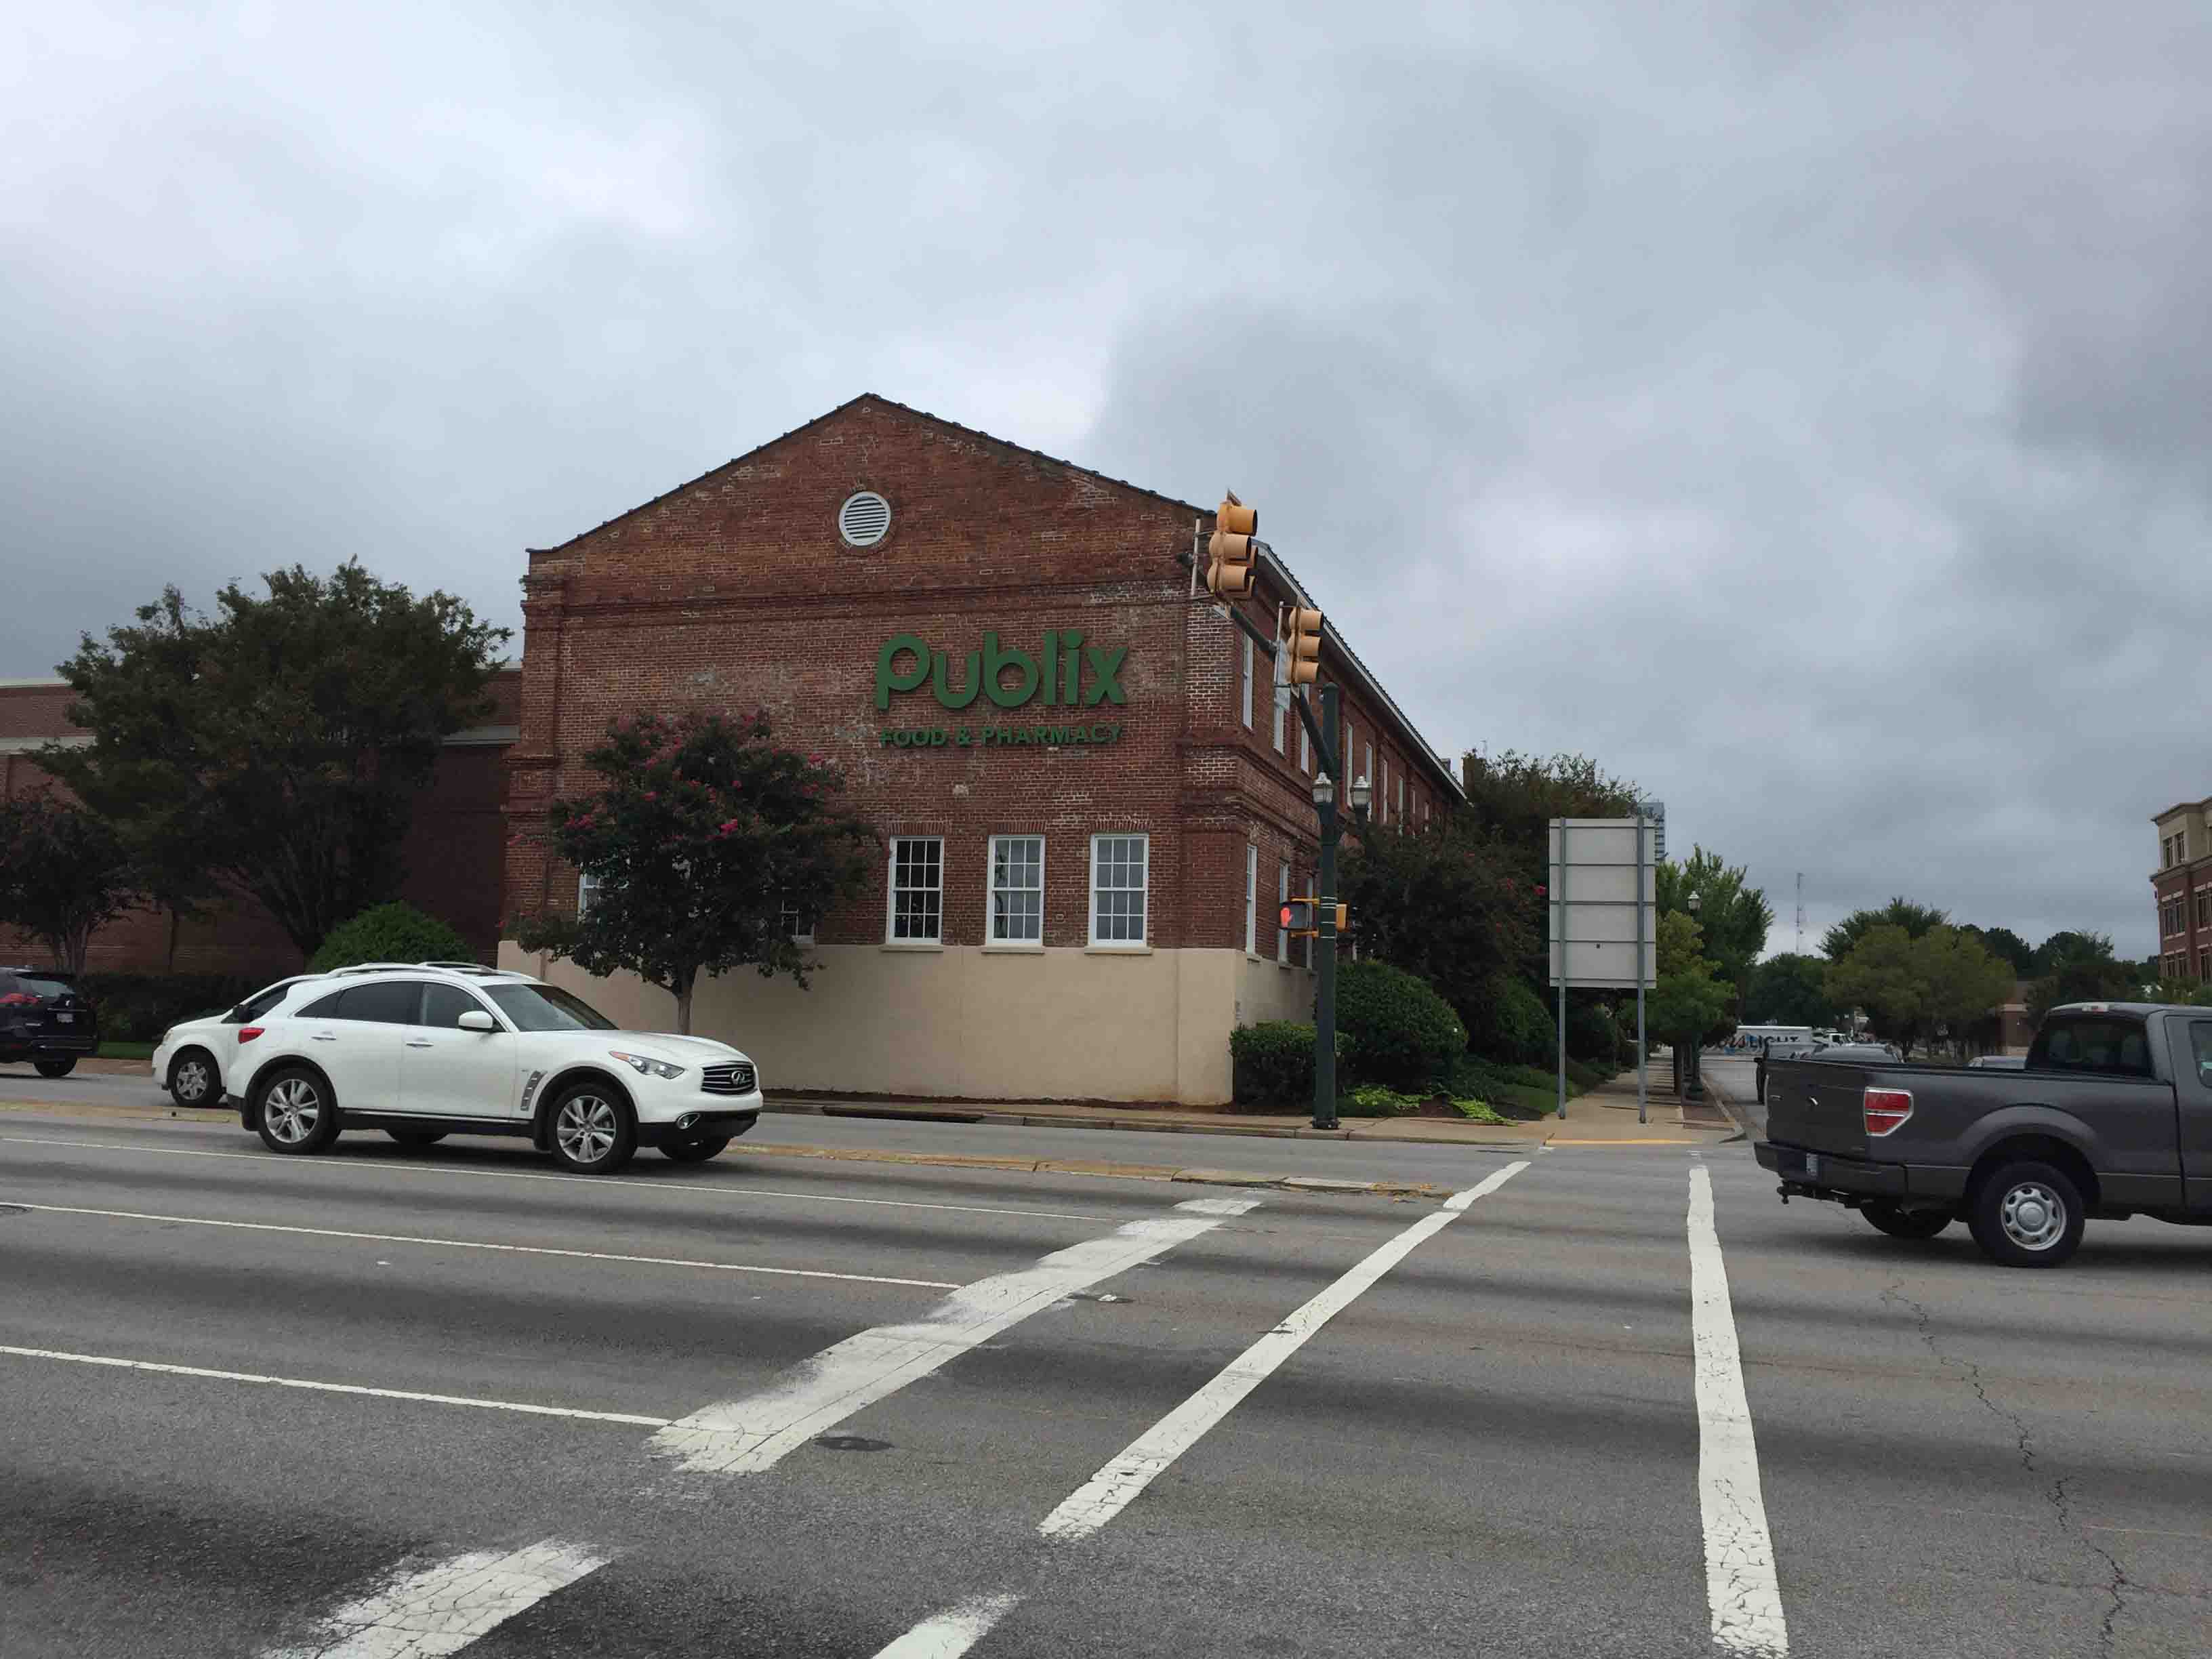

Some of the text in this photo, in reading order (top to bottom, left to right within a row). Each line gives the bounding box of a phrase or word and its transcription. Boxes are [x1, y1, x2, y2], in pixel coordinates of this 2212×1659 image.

[875, 630, 1128, 709] Publix
[880, 726, 1122, 747] FOOD & PHARMACY
